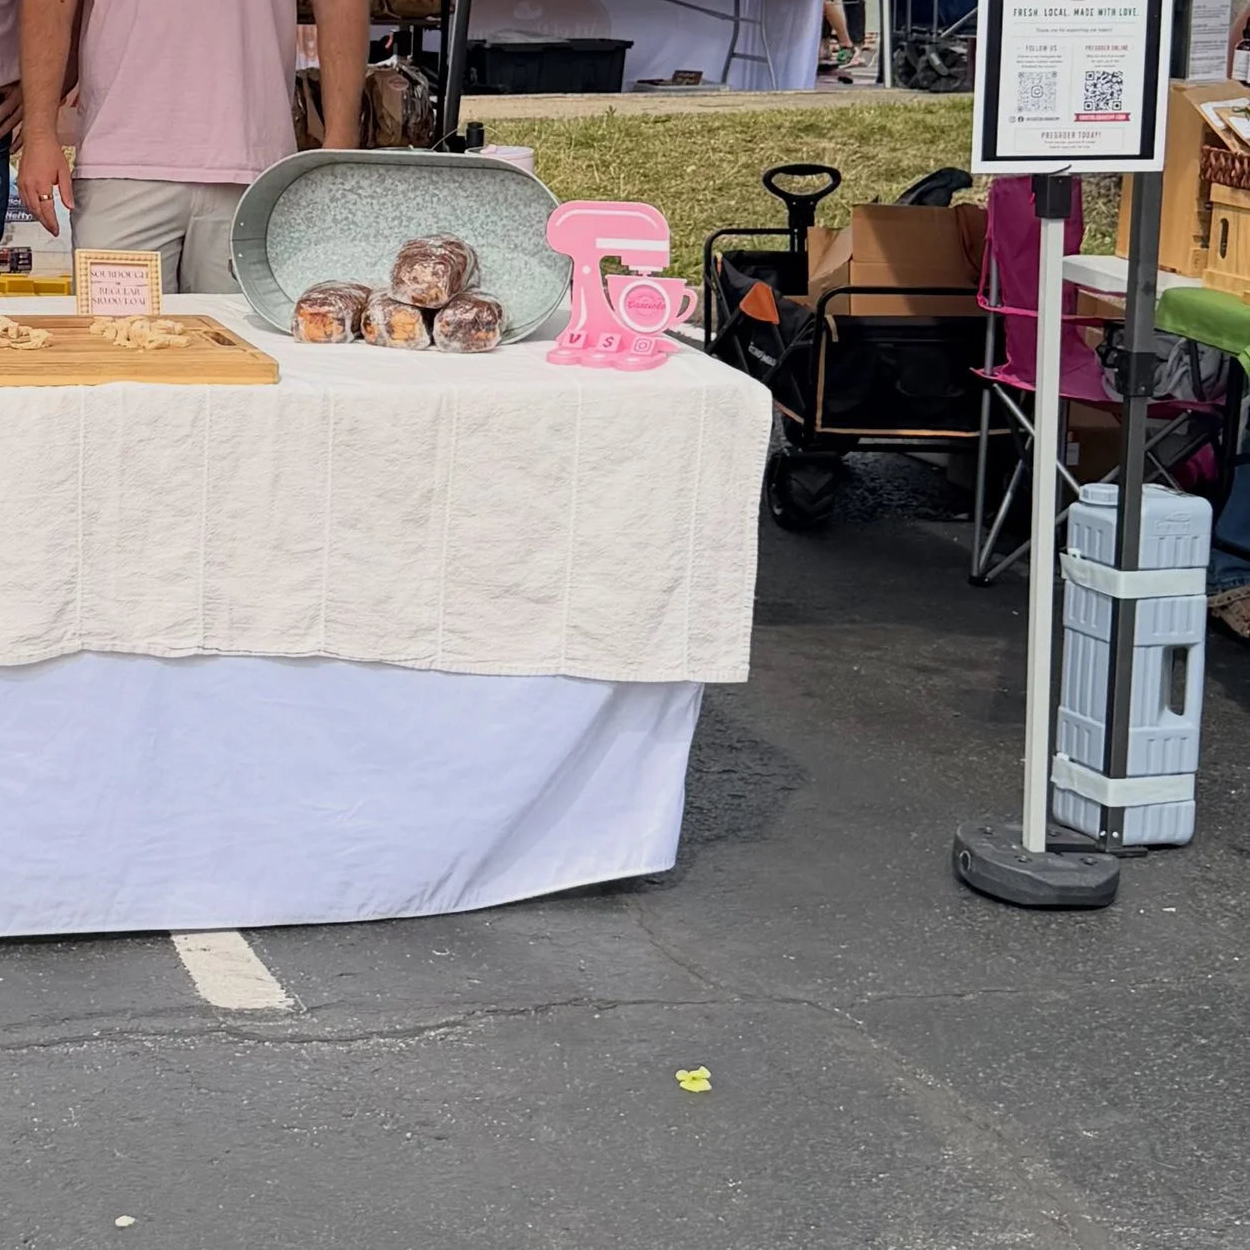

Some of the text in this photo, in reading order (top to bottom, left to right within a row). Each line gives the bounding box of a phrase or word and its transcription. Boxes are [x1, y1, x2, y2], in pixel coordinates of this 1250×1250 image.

[1044, 8, 1070, 17] LOCAL.
[1073, 8, 1094, 17] MADE
[1098, 7, 1116, 16] WITH
[1119, 7, 1139, 16] LOVE.
[1041, 131, 1076, 139] PREORDER
[91, 270, 148, 279] SOURDOUGH
